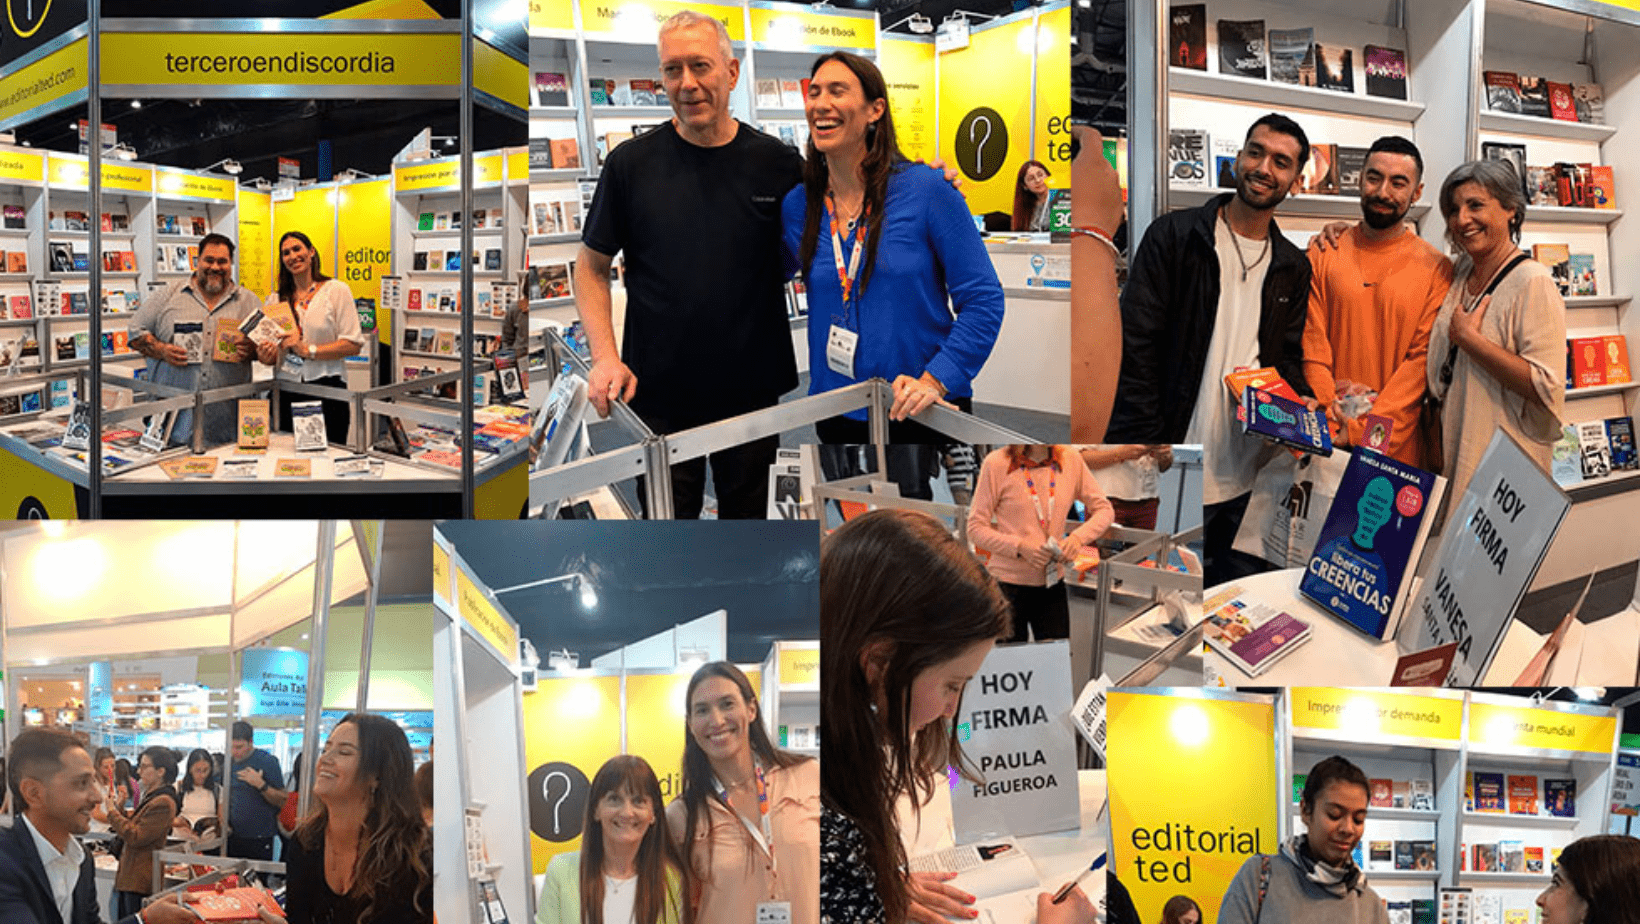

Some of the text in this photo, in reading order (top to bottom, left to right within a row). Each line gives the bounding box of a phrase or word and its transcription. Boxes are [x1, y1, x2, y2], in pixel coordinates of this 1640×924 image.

[165, 52, 395, 73] terceroendiscordia
[346, 265, 372, 281] ted
[1493, 477, 1526, 523] HOY
[1470, 508, 1509, 575] FIRMA
[1310, 556, 1391, 616] CREENCIAS
[1361, 567, 1378, 585] tus
[1434, 567, 1473, 665] VANESA
[261, 682, 288, 692] Aula
[981, 671, 1033, 694] HOY
[972, 705, 1048, 731] FIRMA
[1307, 700, 1343, 715] Impre
[1389, 708, 1441, 724] demanda
[1535, 724, 1576, 738] mundial
[981, 750, 1046, 772] PAULA
[973, 774, 1058, 798] FIGUEROA
[1131, 823, 1260, 855] editorial
[1134, 855, 1192, 883] ted
